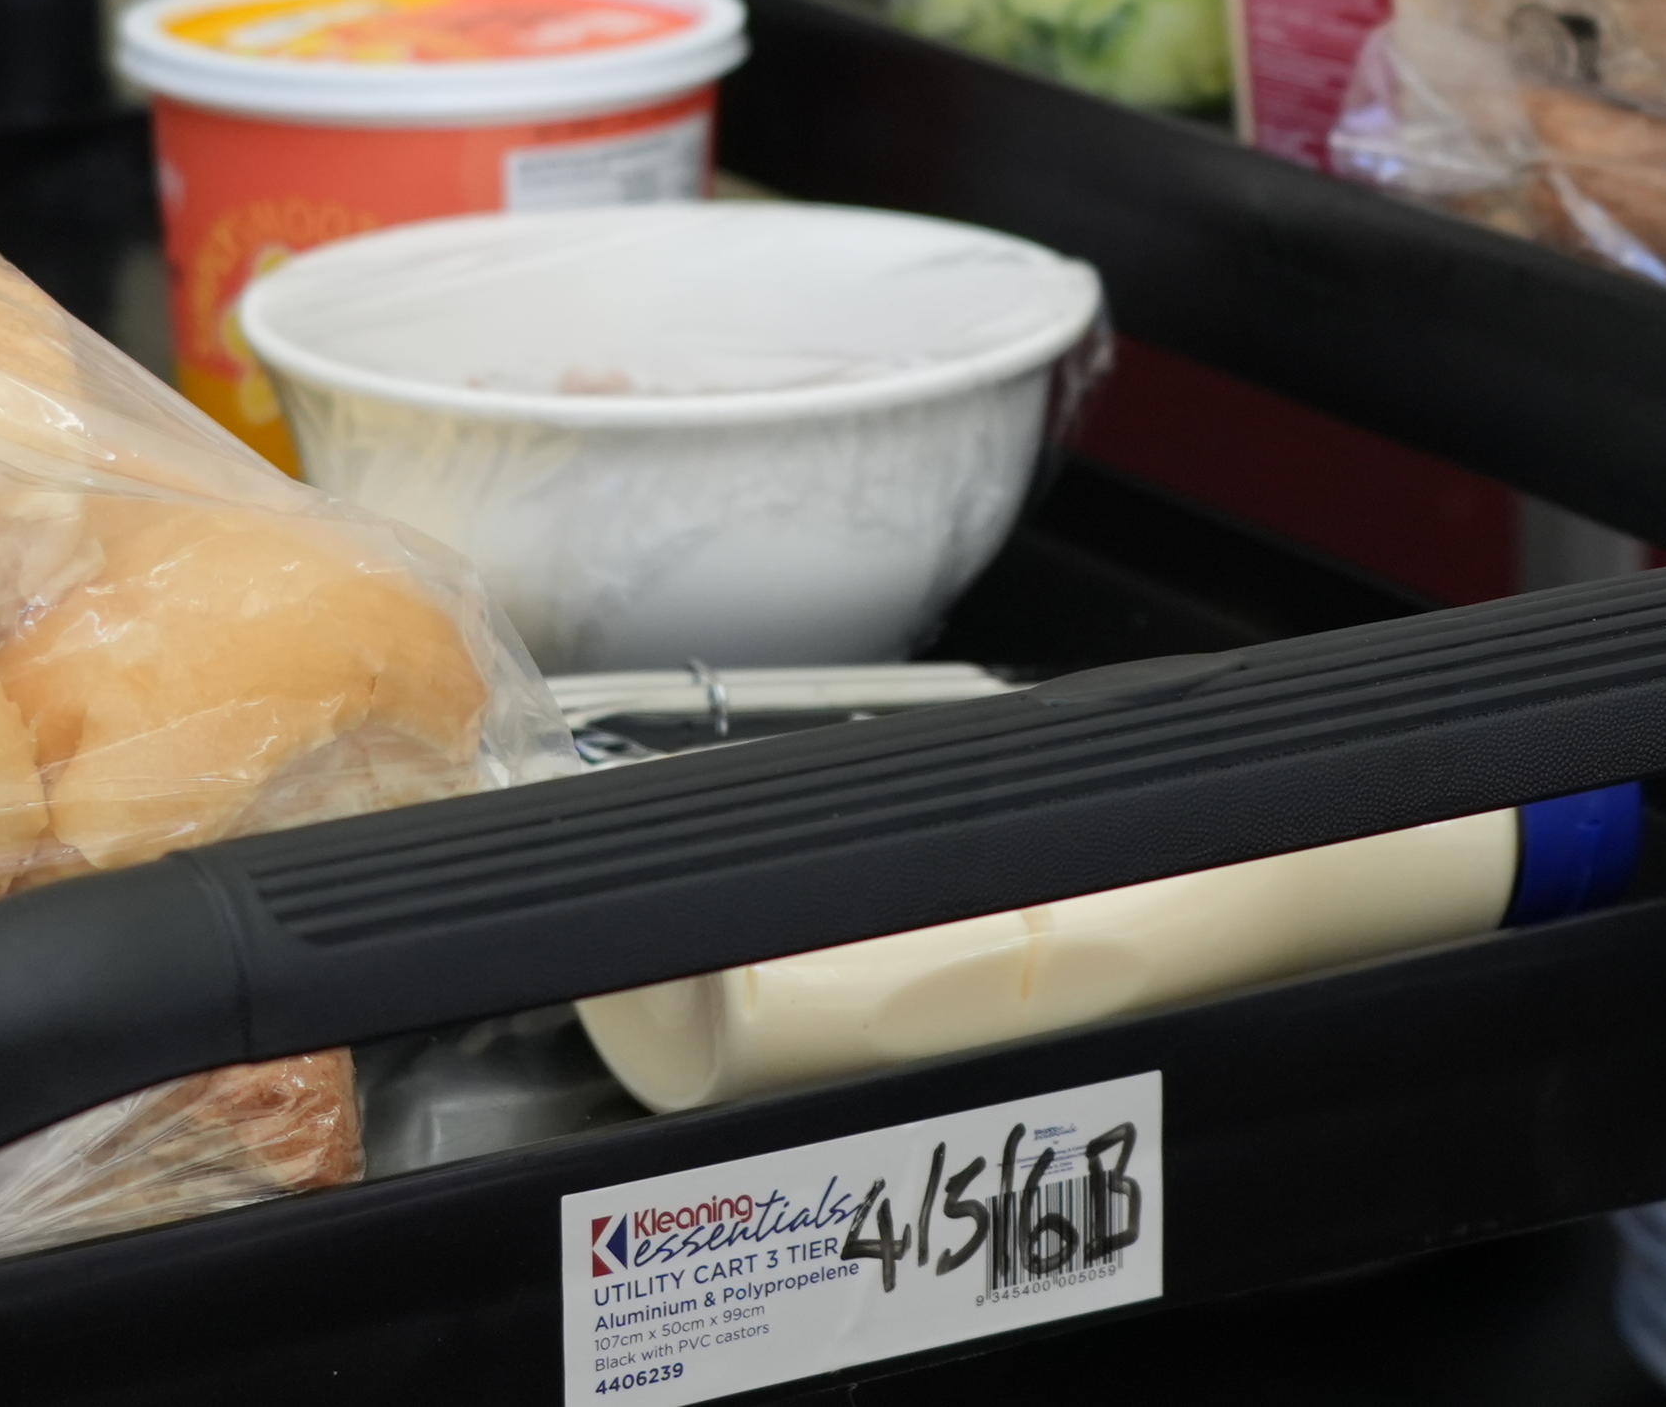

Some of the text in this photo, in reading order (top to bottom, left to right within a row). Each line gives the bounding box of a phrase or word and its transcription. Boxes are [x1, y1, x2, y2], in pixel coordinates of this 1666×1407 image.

[634, 1194, 753, 1239] Kleaning
[634, 1176, 857, 1266] essentials
[594, 1237, 839, 1306] UTILITY CART 3 TIER
[976, 1266, 1117, 1307] 9 345400 005059
[594, 1262, 860, 1332] Aluminium & Polypropelene
[594, 1305, 765, 1351] 107cm x 50cm x 99cm
[595, 1322, 770, 1372] Black with PVC castors
[595, 1362, 684, 1395] 4406239
